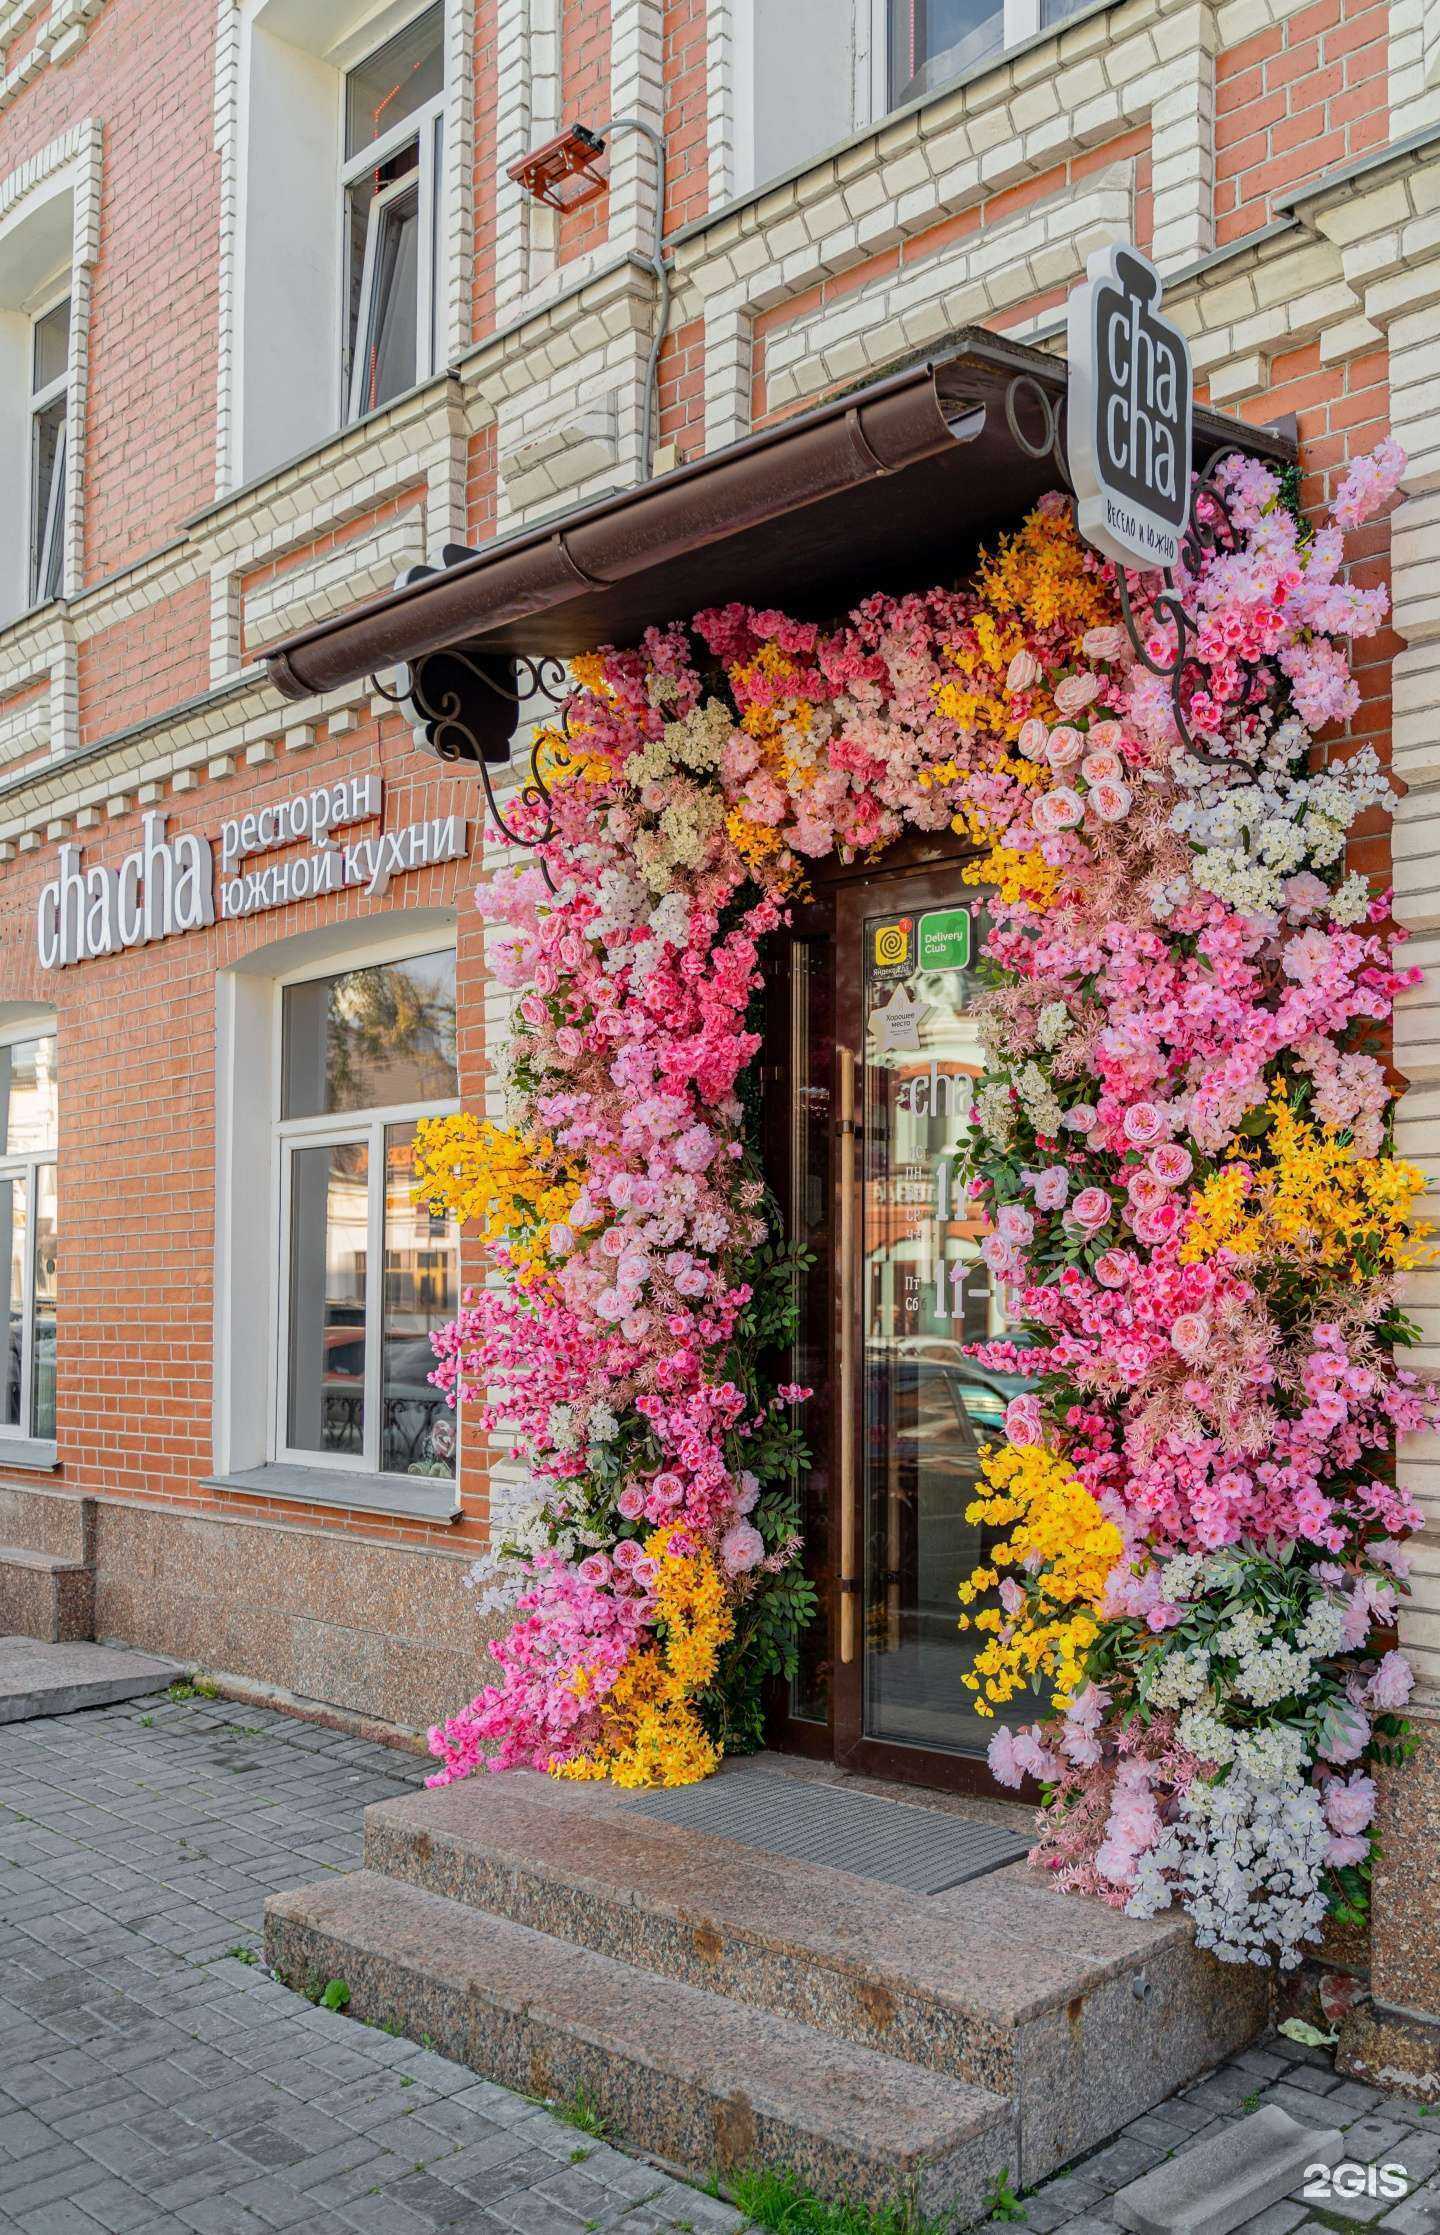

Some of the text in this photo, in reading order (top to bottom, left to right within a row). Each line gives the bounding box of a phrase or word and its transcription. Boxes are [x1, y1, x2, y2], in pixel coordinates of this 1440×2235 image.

[1108, 294, 1178, 424] cha
[1107, 393, 1176, 502] cha
[1106, 498, 1136, 537] ВЕСЕЛО
[1147, 523, 1174, 559] ЮЖНО
[221, 774, 380, 872] ресторан
[37, 810, 214, 969] chacha
[220, 815, 466, 920] южной кухни
[924, 931, 963, 943] Delivery
[924, 944, 947, 954] Club
[886, 1013, 915, 1021] Хорошее
[905, 1297, 919, 1311] Сб
